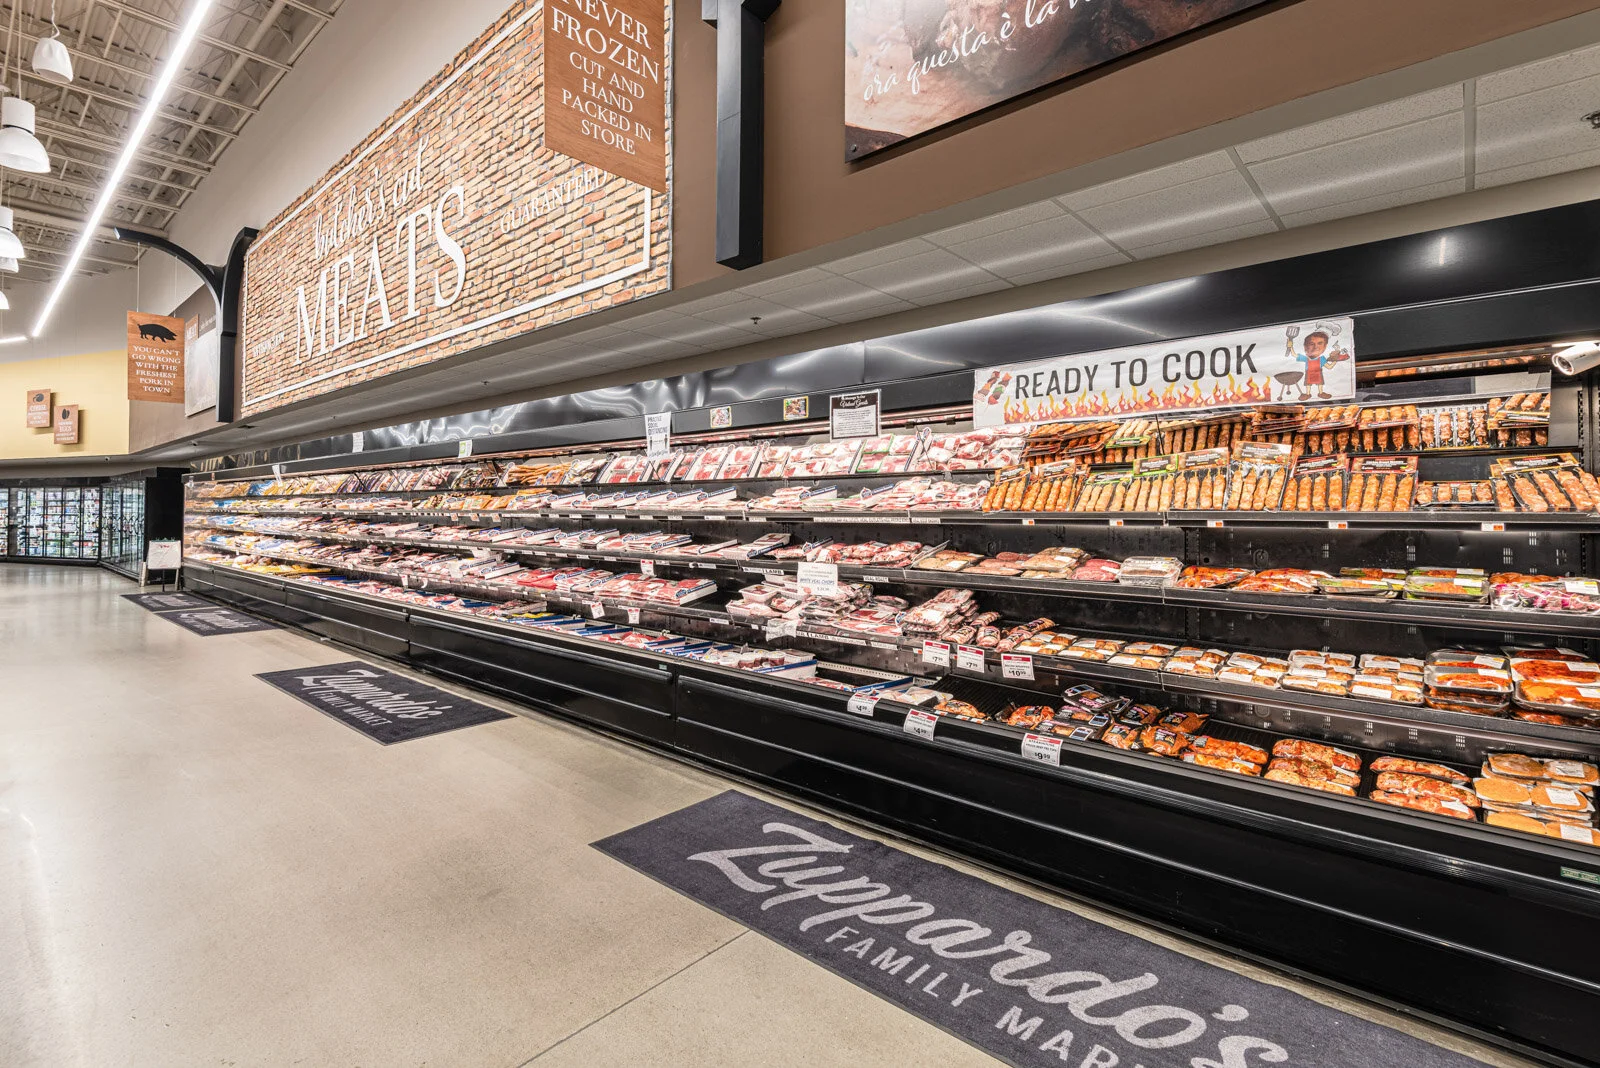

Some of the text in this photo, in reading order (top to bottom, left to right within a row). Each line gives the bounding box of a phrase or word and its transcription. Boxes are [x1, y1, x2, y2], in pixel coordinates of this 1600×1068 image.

[551, 7, 659, 84] FROZEN
[864, 0, 1059, 101] ora questa è la
[570, 52, 645, 99] CUT AND
[583, 78, 633, 113] HAND
[562, 88, 652, 142] PACKED IN
[582, 120, 636, 155] STORE
[315, 167, 386, 261] butcher's
[500, 166, 607, 234] GUARANTEED
[294, 185, 466, 366] MEATS
[136, 370, 177, 378] FRESHEST
[154, 348, 180, 356] CAN'T
[1015, 343, 1258, 399] READY TO COOK
[344, 706, 392, 726] MARKET
[824, 924, 1145, 1068] FAMILY MAR
